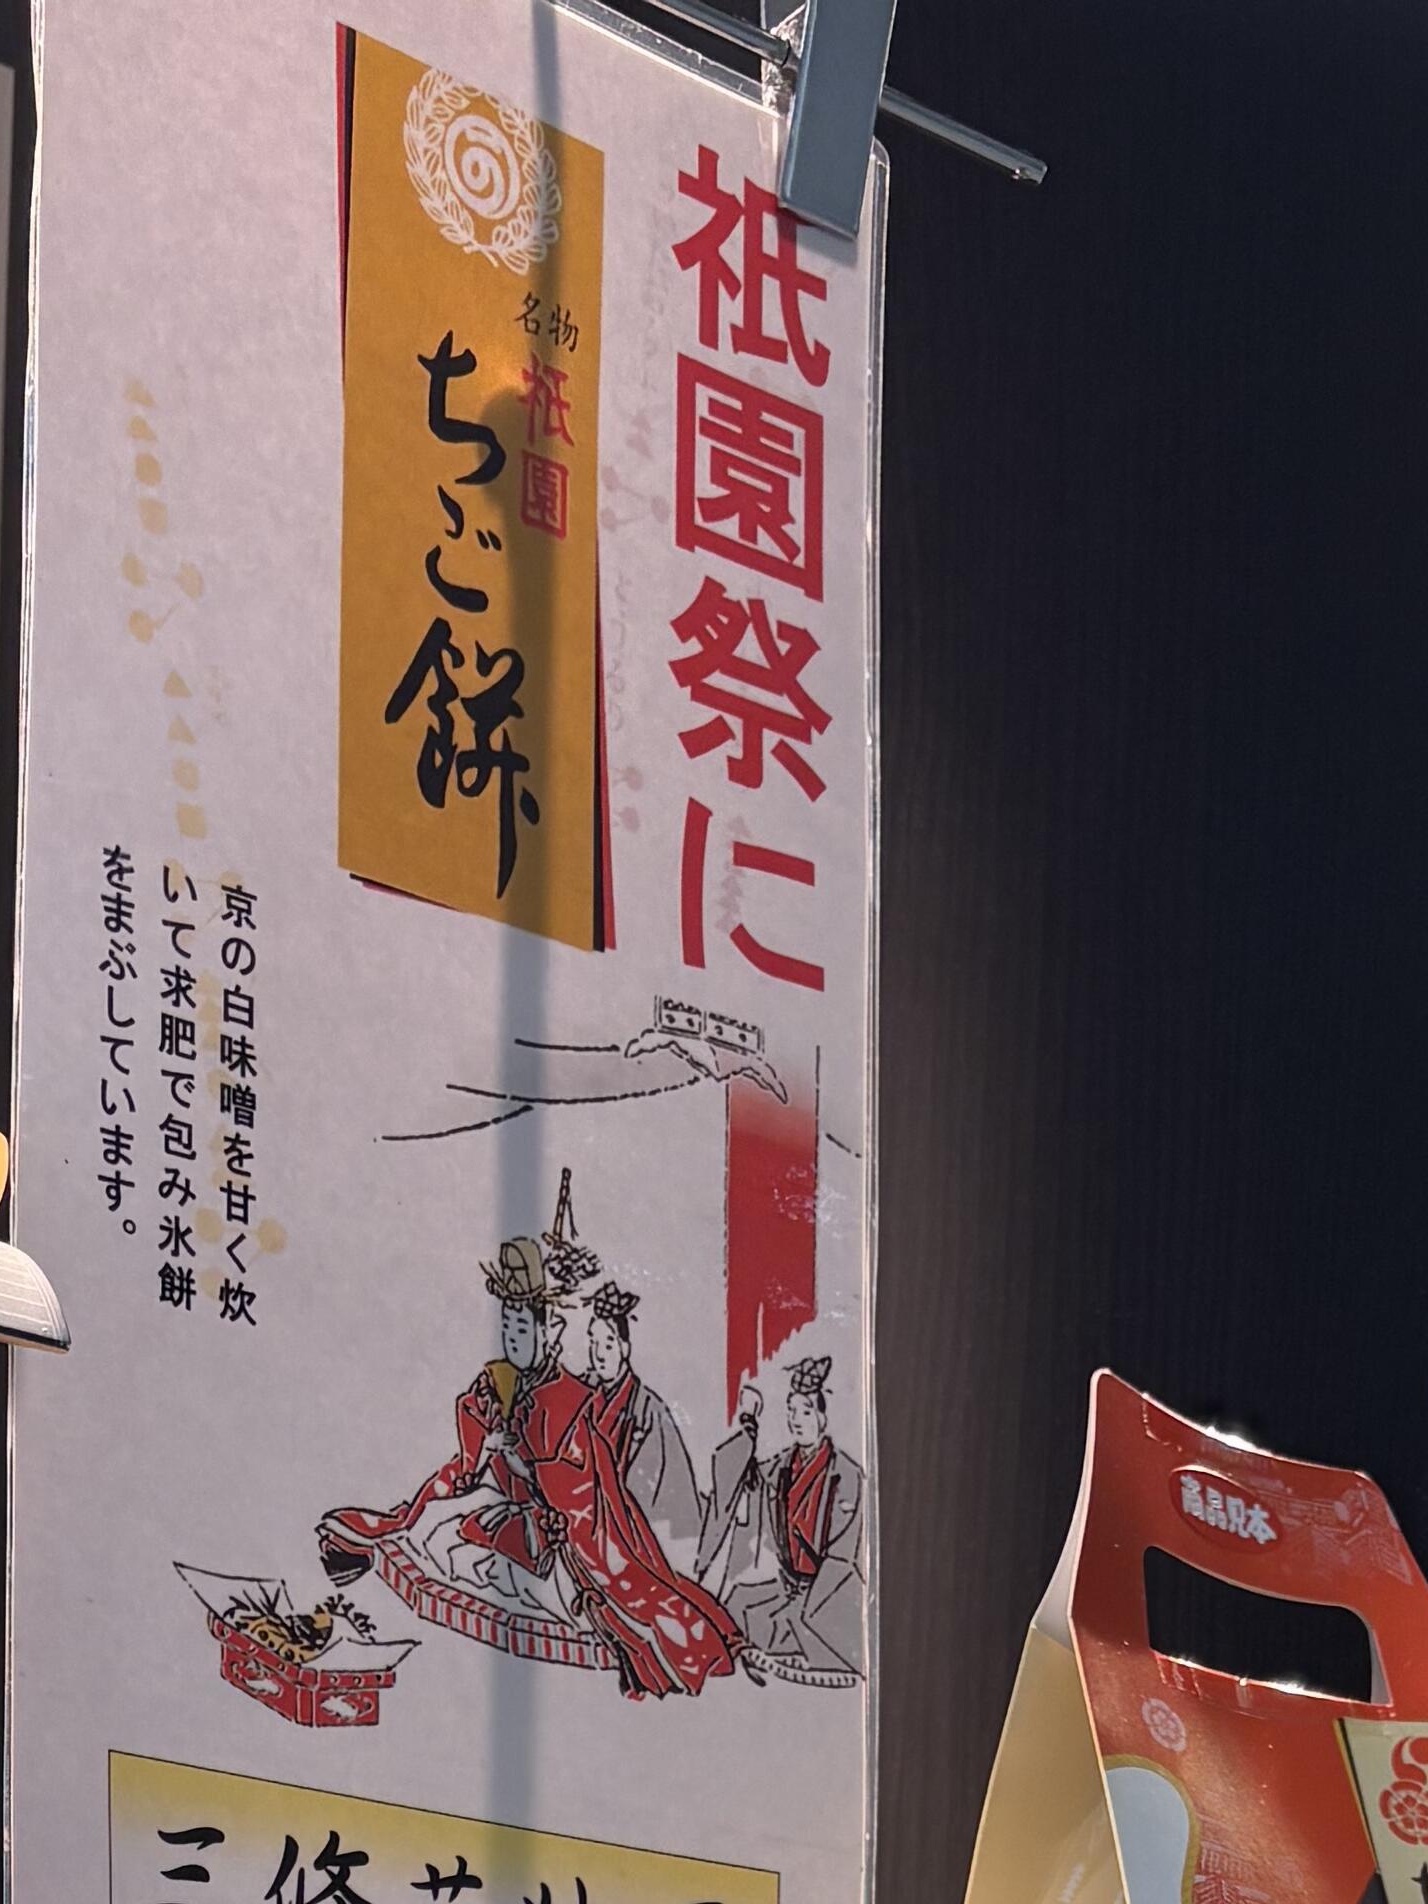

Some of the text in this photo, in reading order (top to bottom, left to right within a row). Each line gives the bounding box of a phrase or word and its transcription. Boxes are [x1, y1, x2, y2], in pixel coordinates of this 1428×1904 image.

[514, 290, 580, 353] 名物
[519, 353, 576, 541] 祇園
[383, 330, 541, 899] ちご餅
[670, 144, 833, 993] 祇園祭に
[97, 844, 138, 1236] をまぶしています。
[158, 864, 198, 1311] いて求肥で包み氷餅
[219, 884, 258, 1326] 京の白味噌を甘く炊
[1179, 1474, 1278, 1547] 商品見本
